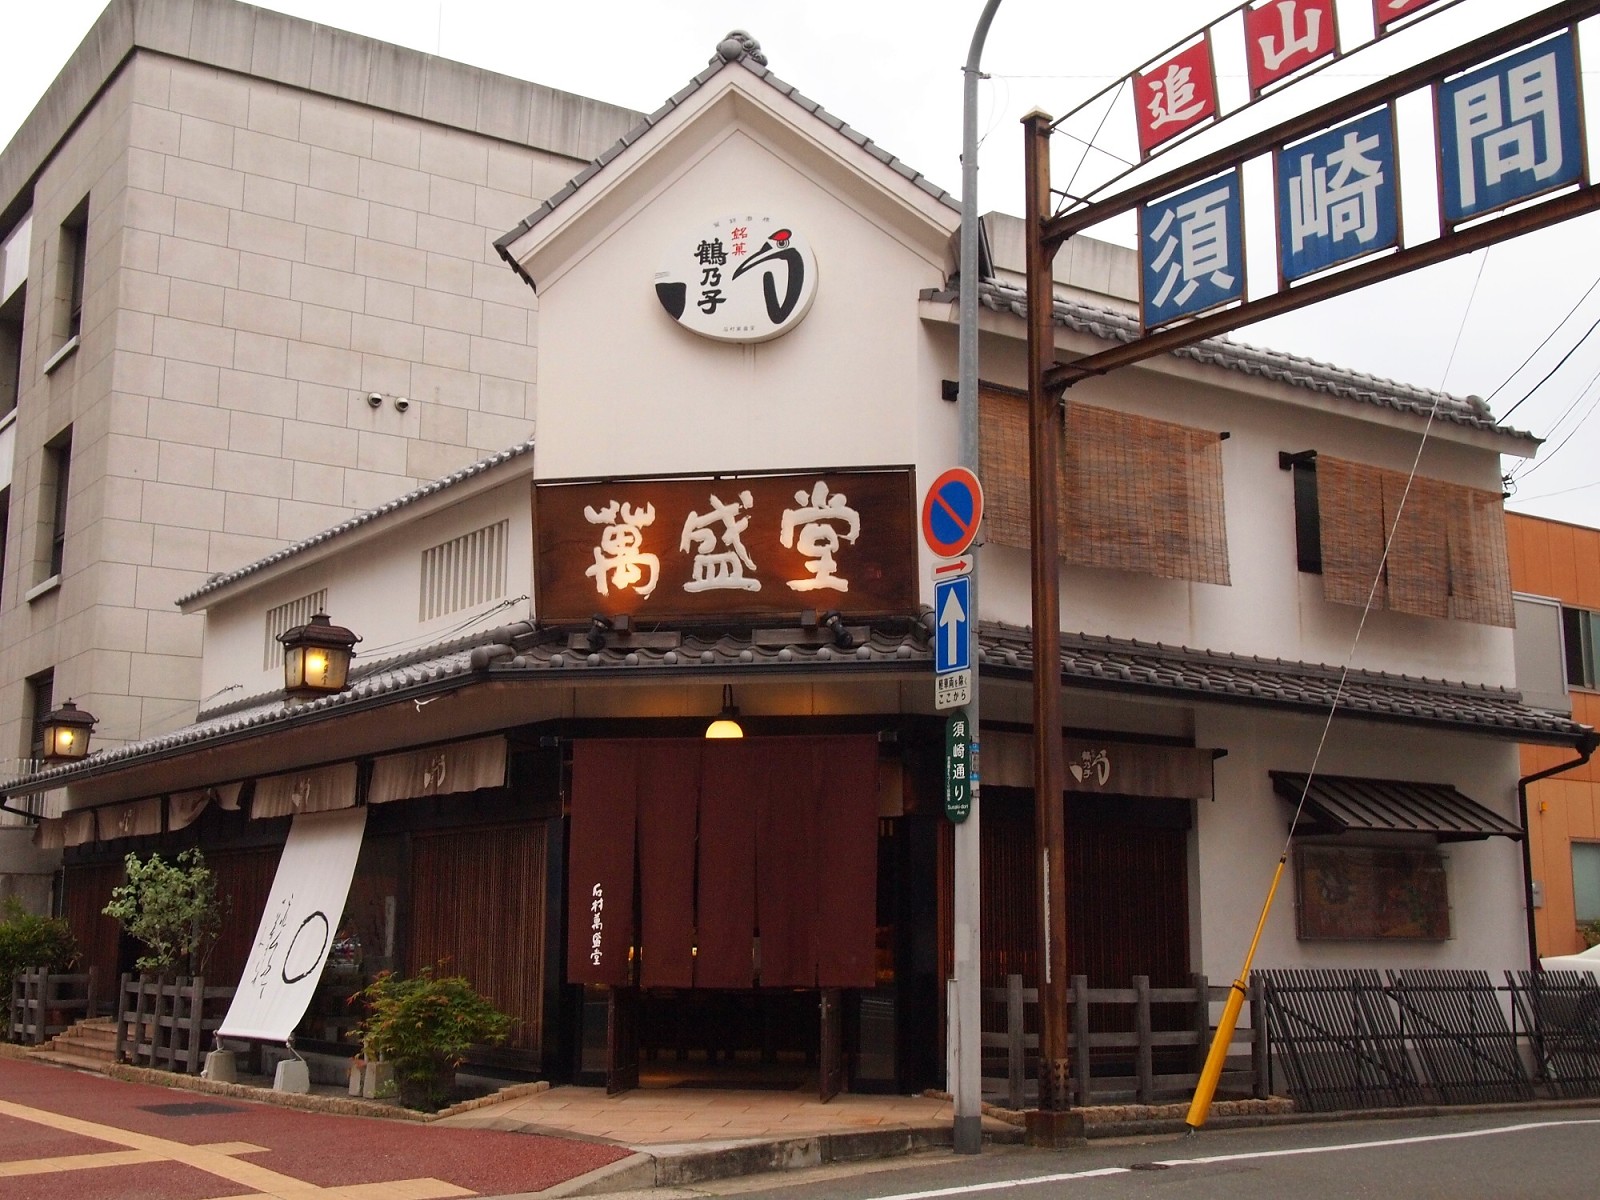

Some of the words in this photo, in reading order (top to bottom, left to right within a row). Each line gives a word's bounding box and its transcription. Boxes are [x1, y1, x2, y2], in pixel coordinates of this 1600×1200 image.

[1149, 52, 1564, 308] 須崎問
[694, 238, 728, 315] 鶴乃子
[731, 227, 748, 256] 銘菓
[583, 480, 861, 600] 萬盛堂
[939, 689, 966, 704] ここから
[953, 721, 965, 801] 須崎通り
[591, 883, 603, 965] 石村萬盛堂
